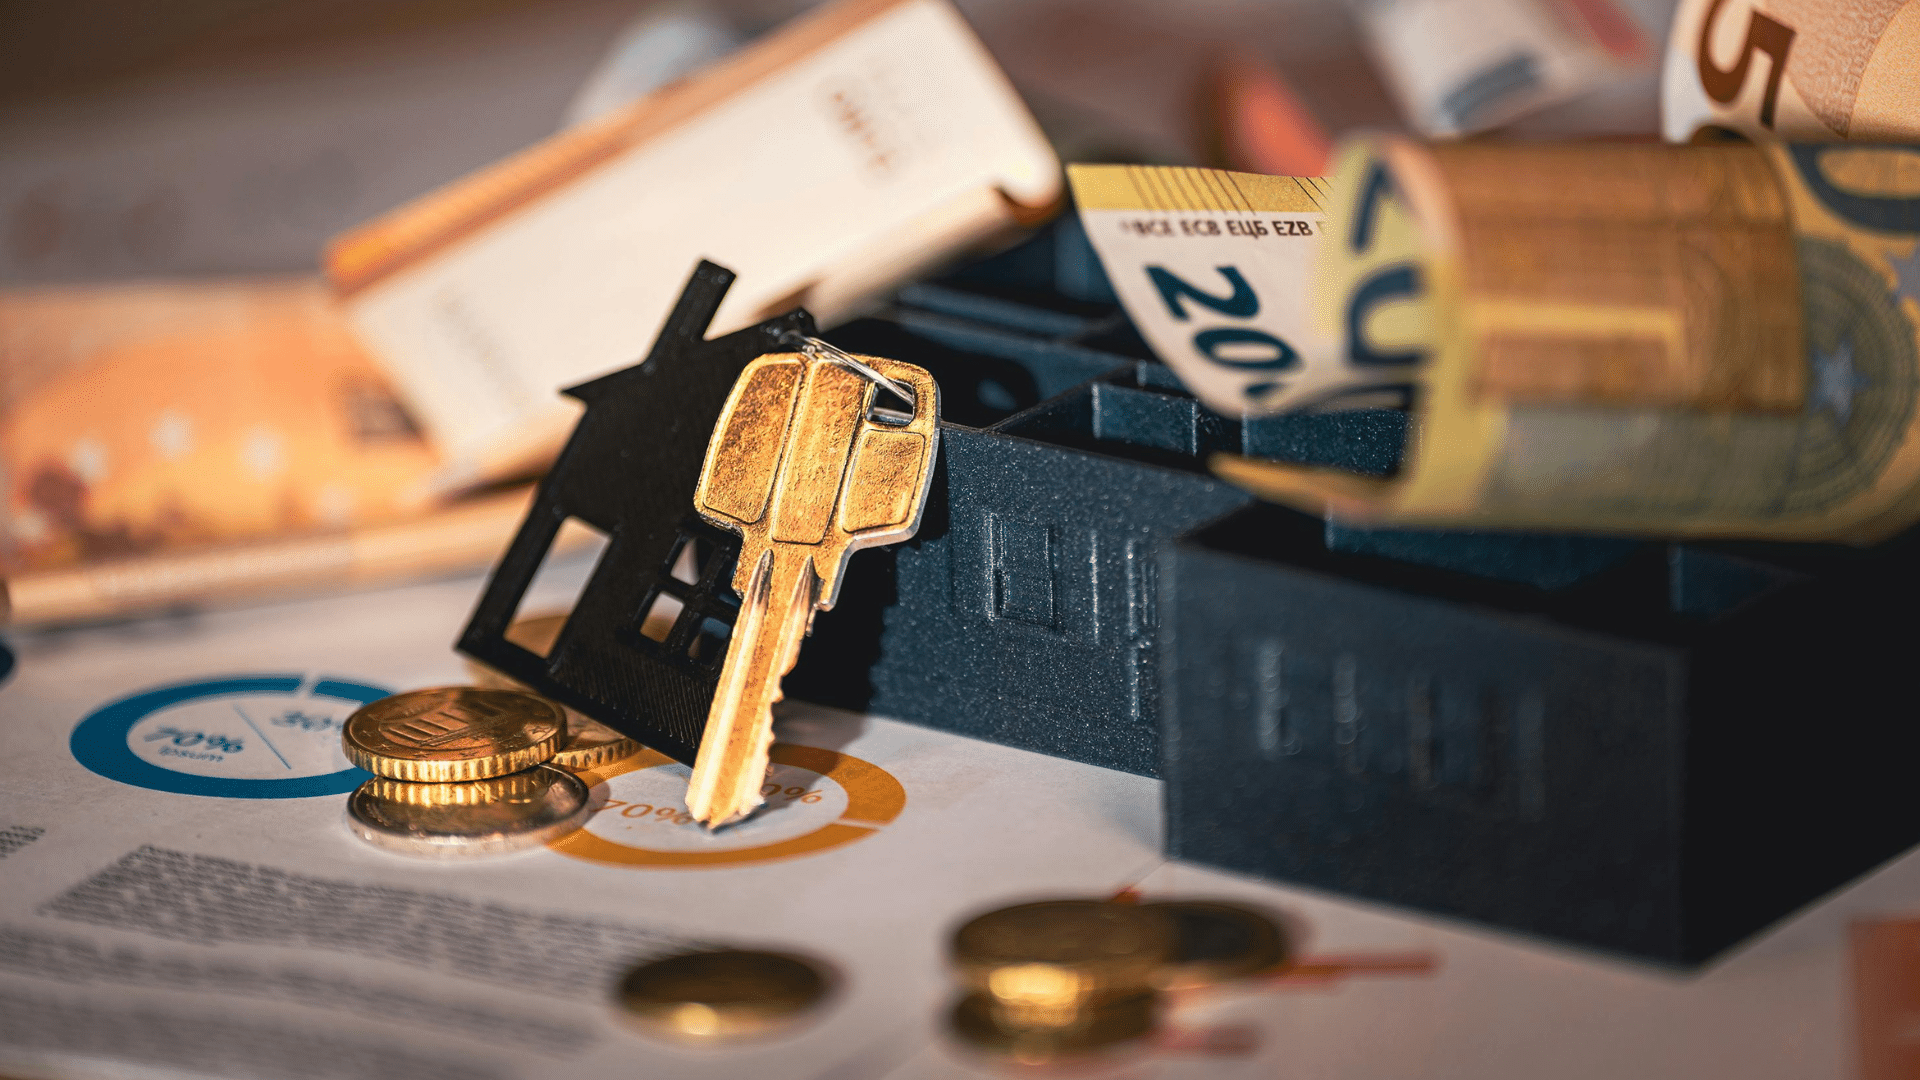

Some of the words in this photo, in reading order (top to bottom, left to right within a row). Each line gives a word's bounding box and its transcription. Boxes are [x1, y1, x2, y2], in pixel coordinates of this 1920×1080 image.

[1179, 218, 1221, 237] ECB
[1271, 220, 1313, 237] EZB
[1144, 264, 1306, 400] 20
[143, 724, 244, 754] 70%
[591, 798, 696, 826] 70%
